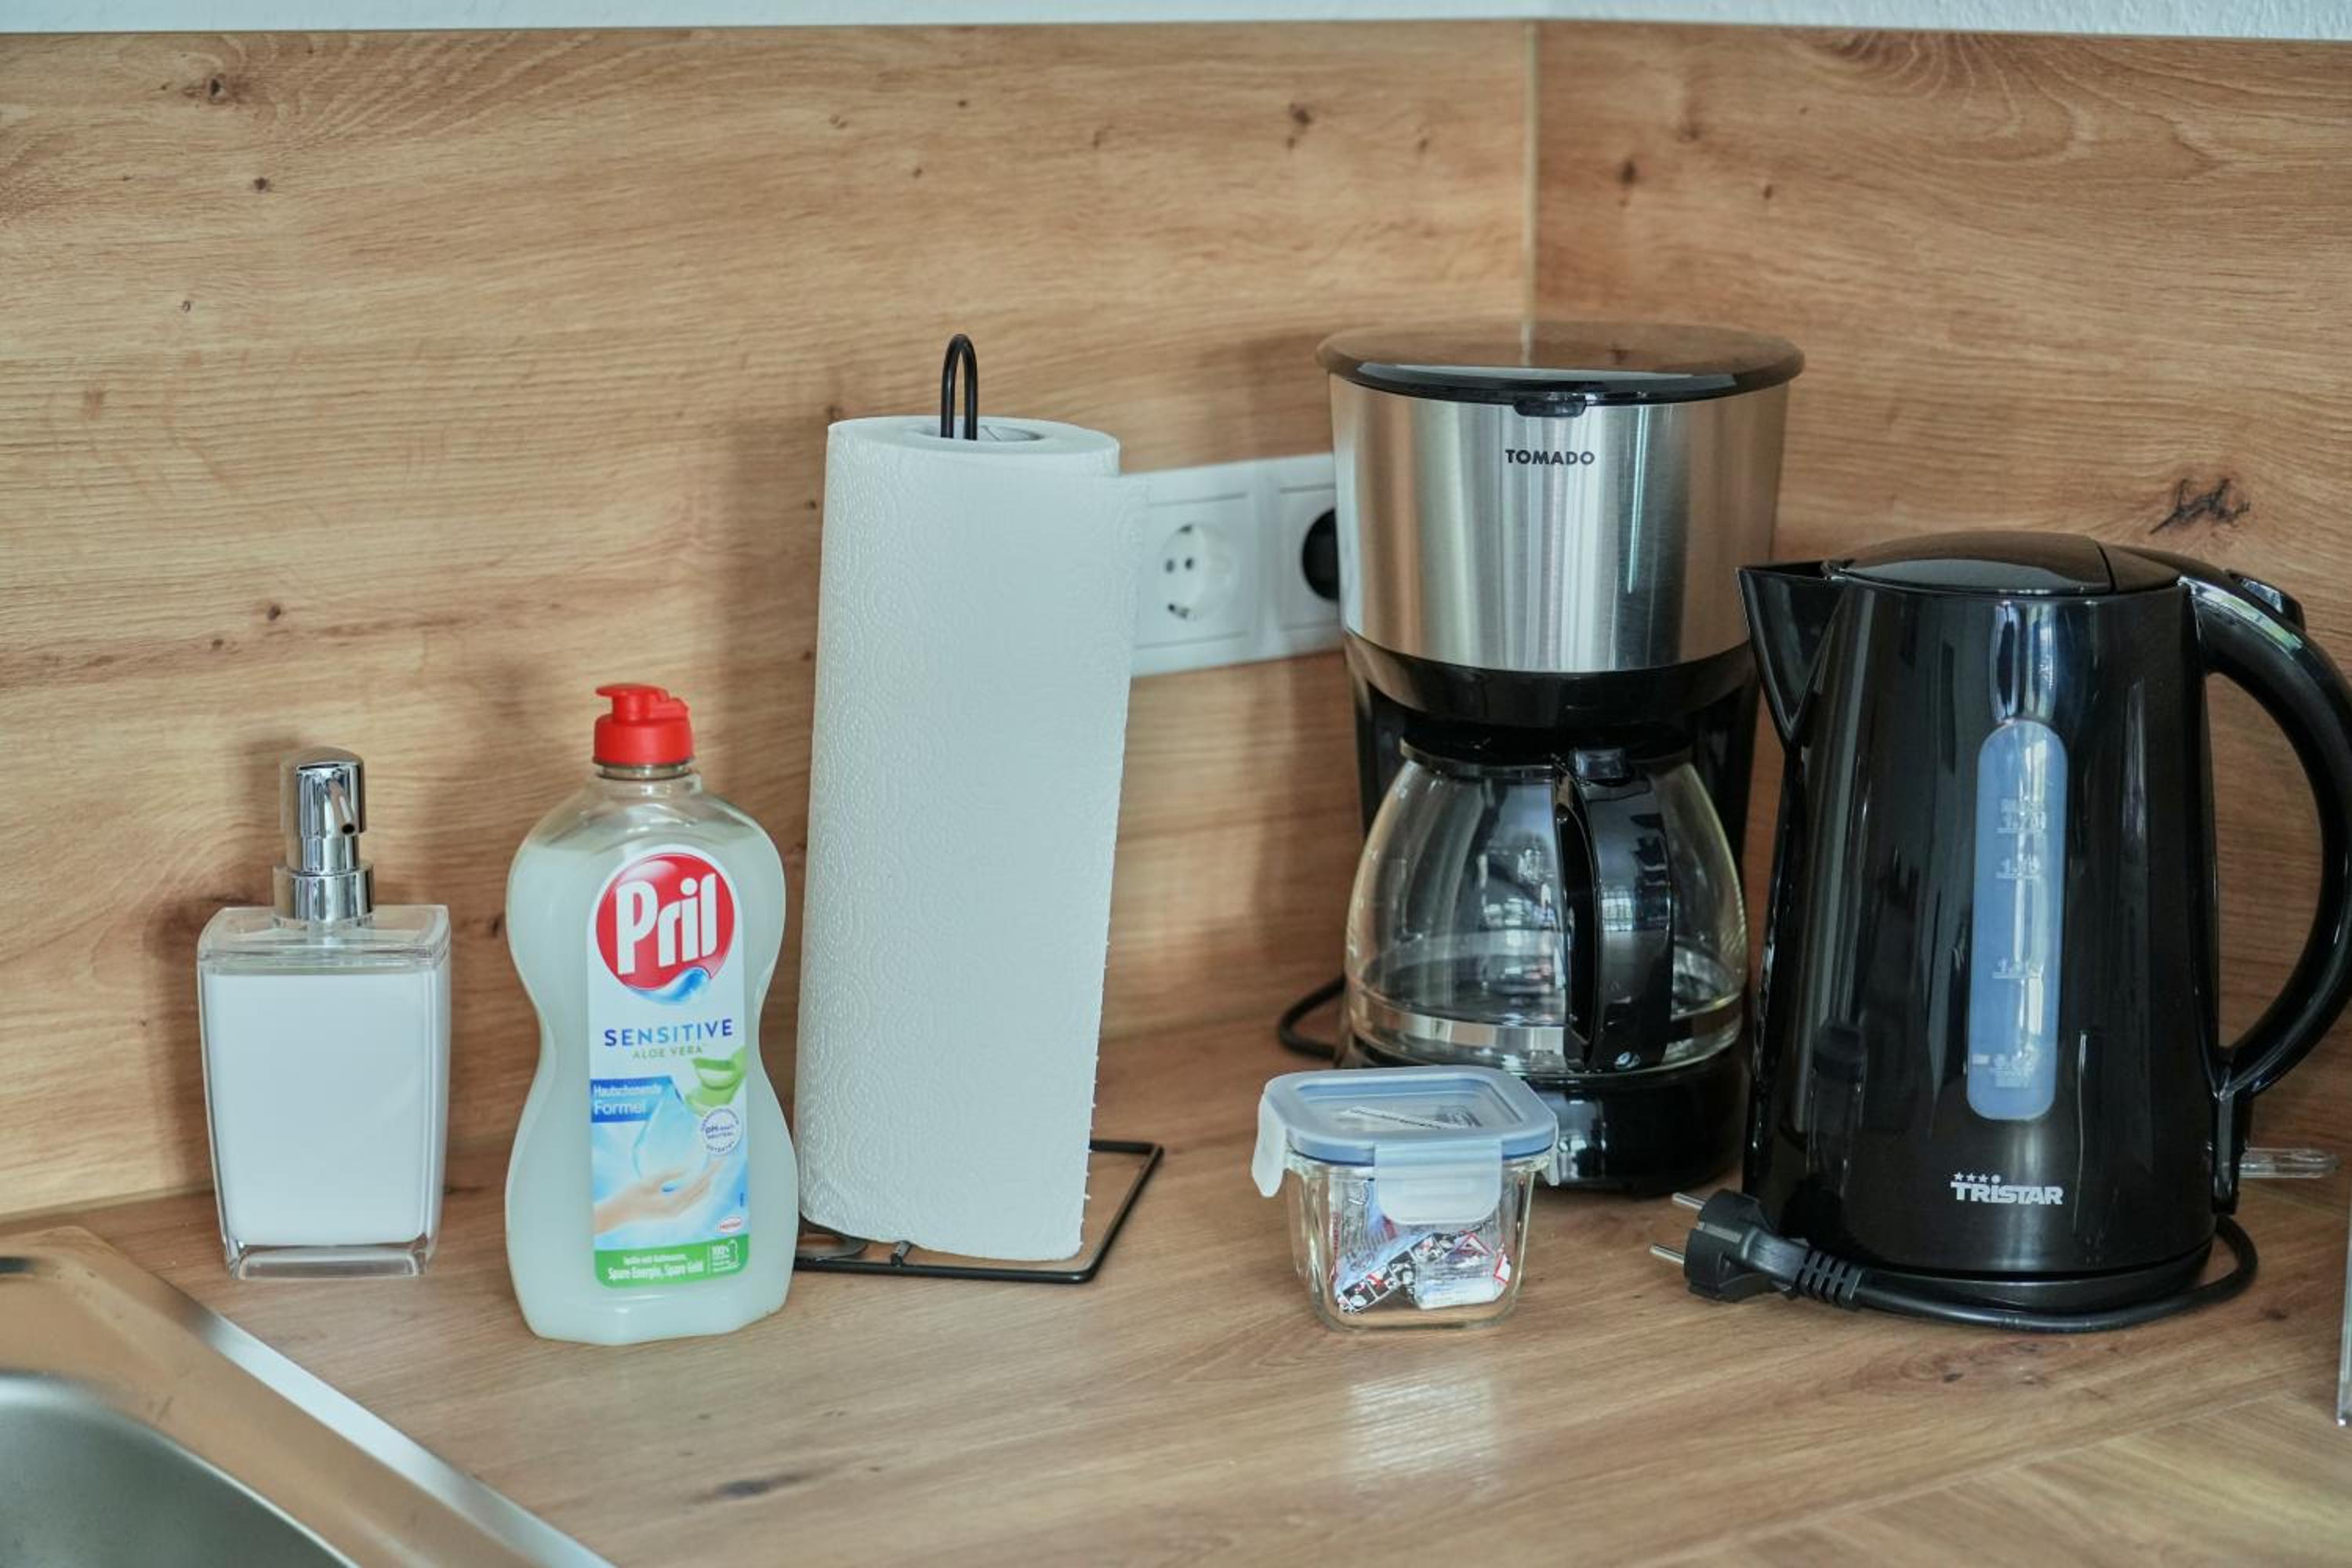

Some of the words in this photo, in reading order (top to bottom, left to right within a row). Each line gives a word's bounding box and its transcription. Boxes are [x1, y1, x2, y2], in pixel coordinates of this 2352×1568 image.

[1505, 449, 1595, 465] TOMADO
[615, 873, 718, 975] Pril
[604, 1018, 734, 1047] SENSITIVE
[632, 1047, 666, 1060] ALOE
[670, 1044, 703, 1057] VERA
[593, 1100, 646, 1116] Formel
[1950, 1174, 2063, 1205] TRISTAR
